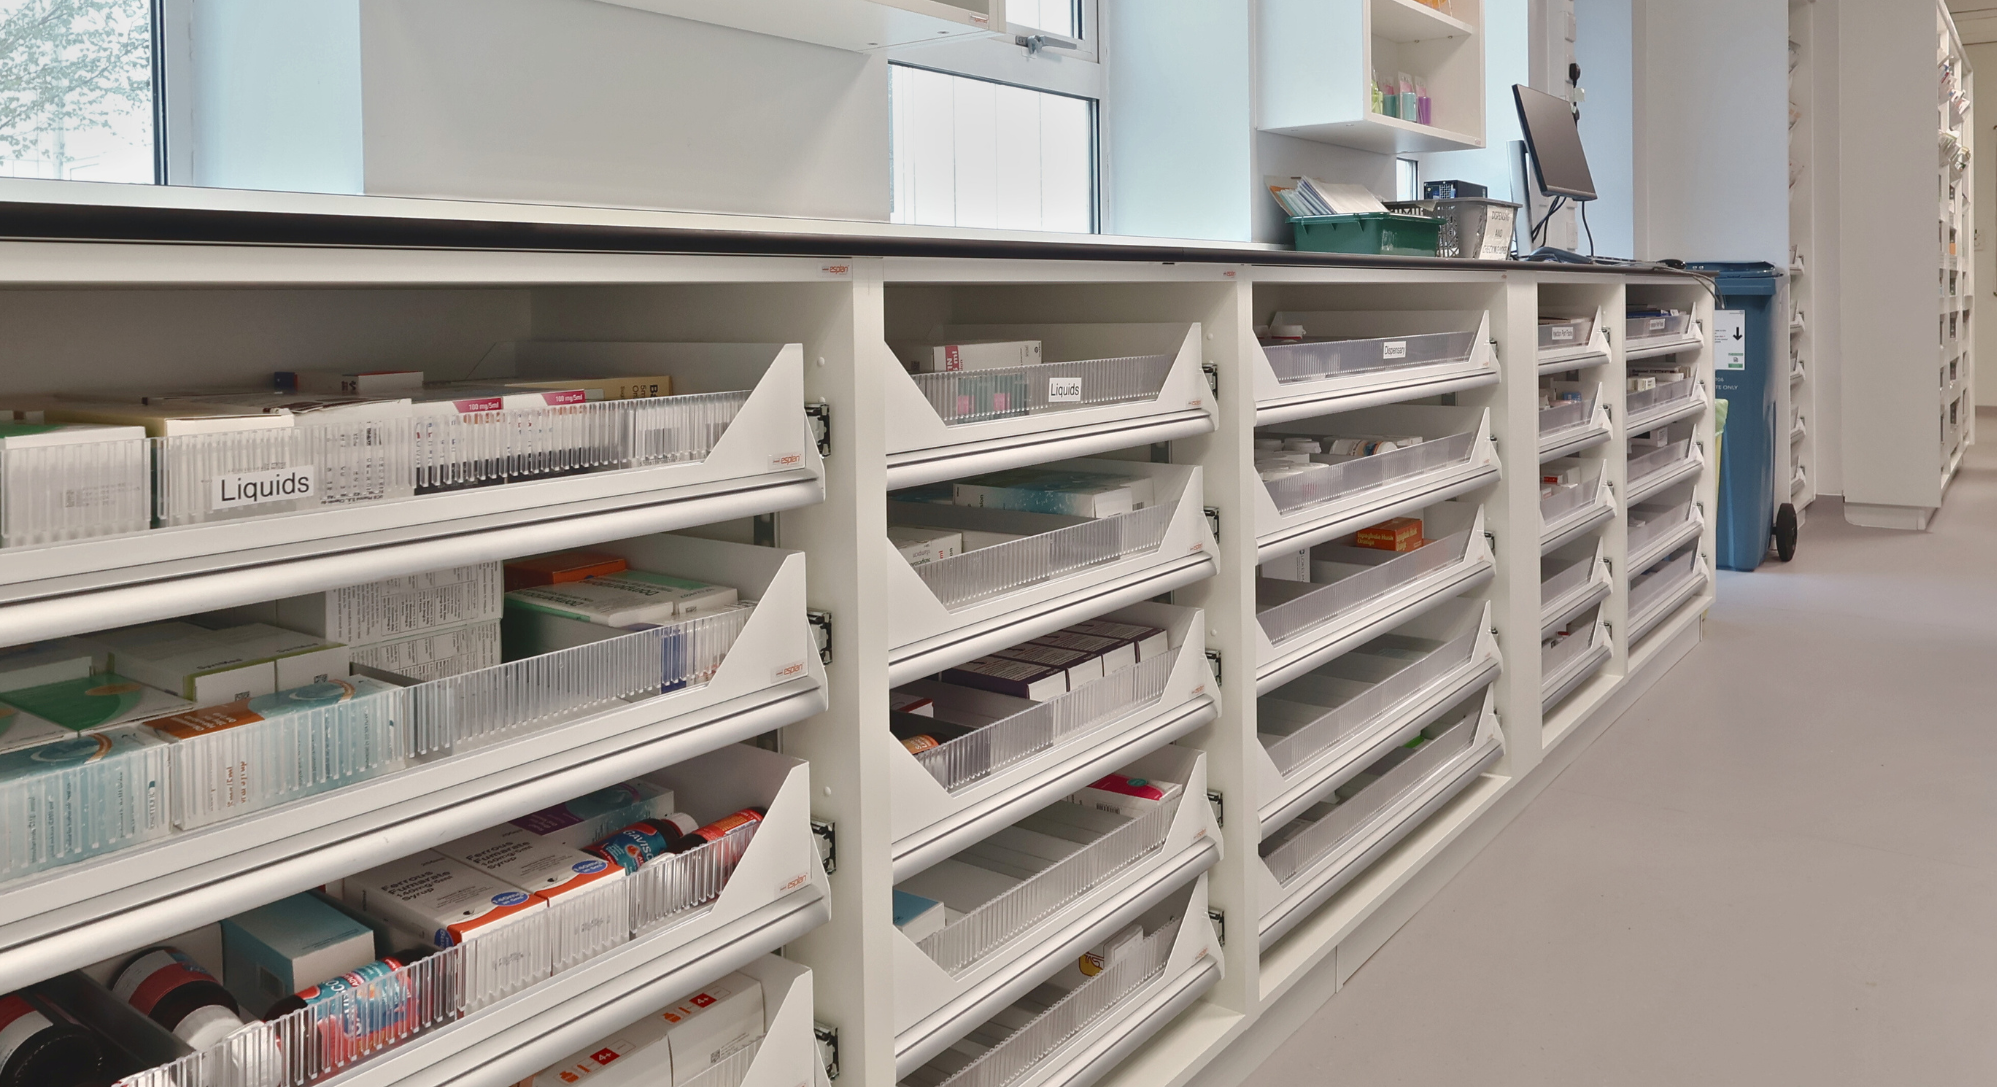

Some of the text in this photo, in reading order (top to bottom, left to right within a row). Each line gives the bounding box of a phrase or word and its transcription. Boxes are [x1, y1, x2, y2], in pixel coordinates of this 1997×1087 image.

[1050, 382, 1080, 397] Liquids
[221, 472, 309, 502] Liquids
[466, 841, 514, 861] Ferrous
[473, 841, 531, 864] Fumarate
[487, 856, 518, 869] Syrup
[381, 871, 434, 892] Ferrous
[388, 871, 451, 895] Fumarate
[401, 887, 435, 901] Syrup
[697, 996, 709, 1005] 4+
[598, 1052, 611, 1061] 4+
